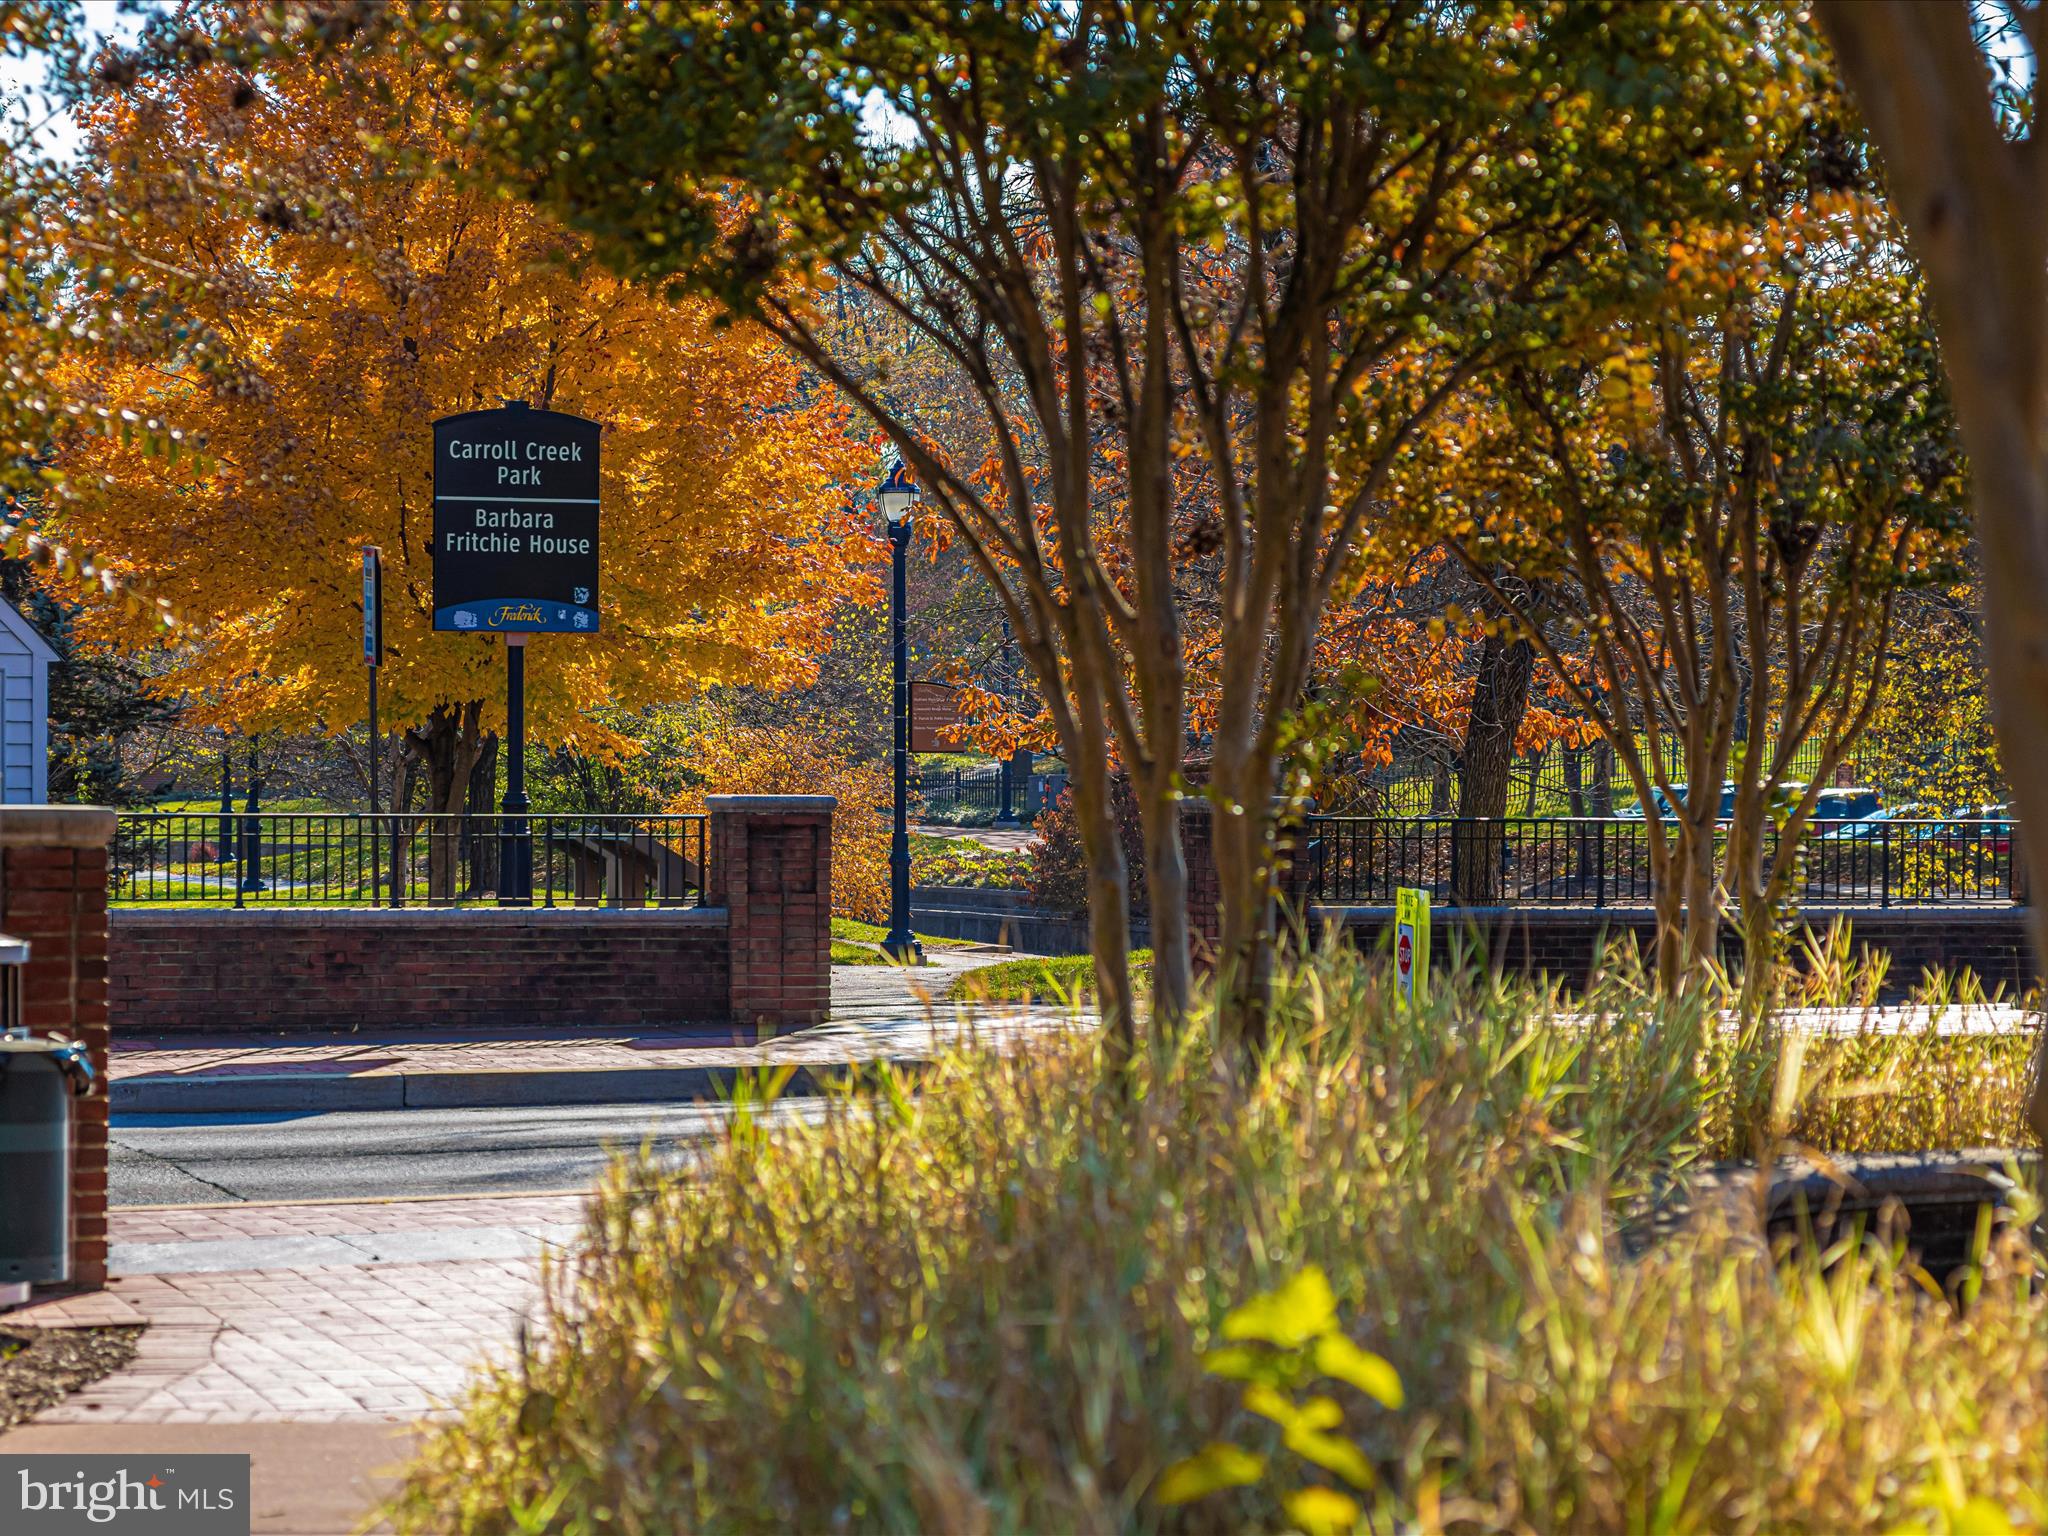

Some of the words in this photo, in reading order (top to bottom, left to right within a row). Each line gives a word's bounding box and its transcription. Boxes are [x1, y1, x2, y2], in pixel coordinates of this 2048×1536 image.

[449, 439, 517, 461] Carroll
[525, 441, 582, 462] Creek
[497, 466, 542, 486] Park
[475, 508, 554, 529] Barbara
[446, 532, 521, 553] Fritchie
[529, 534, 590, 554] House
[488, 603, 547, 627] Frederick
[1399, 947, 1411, 962] STOP
